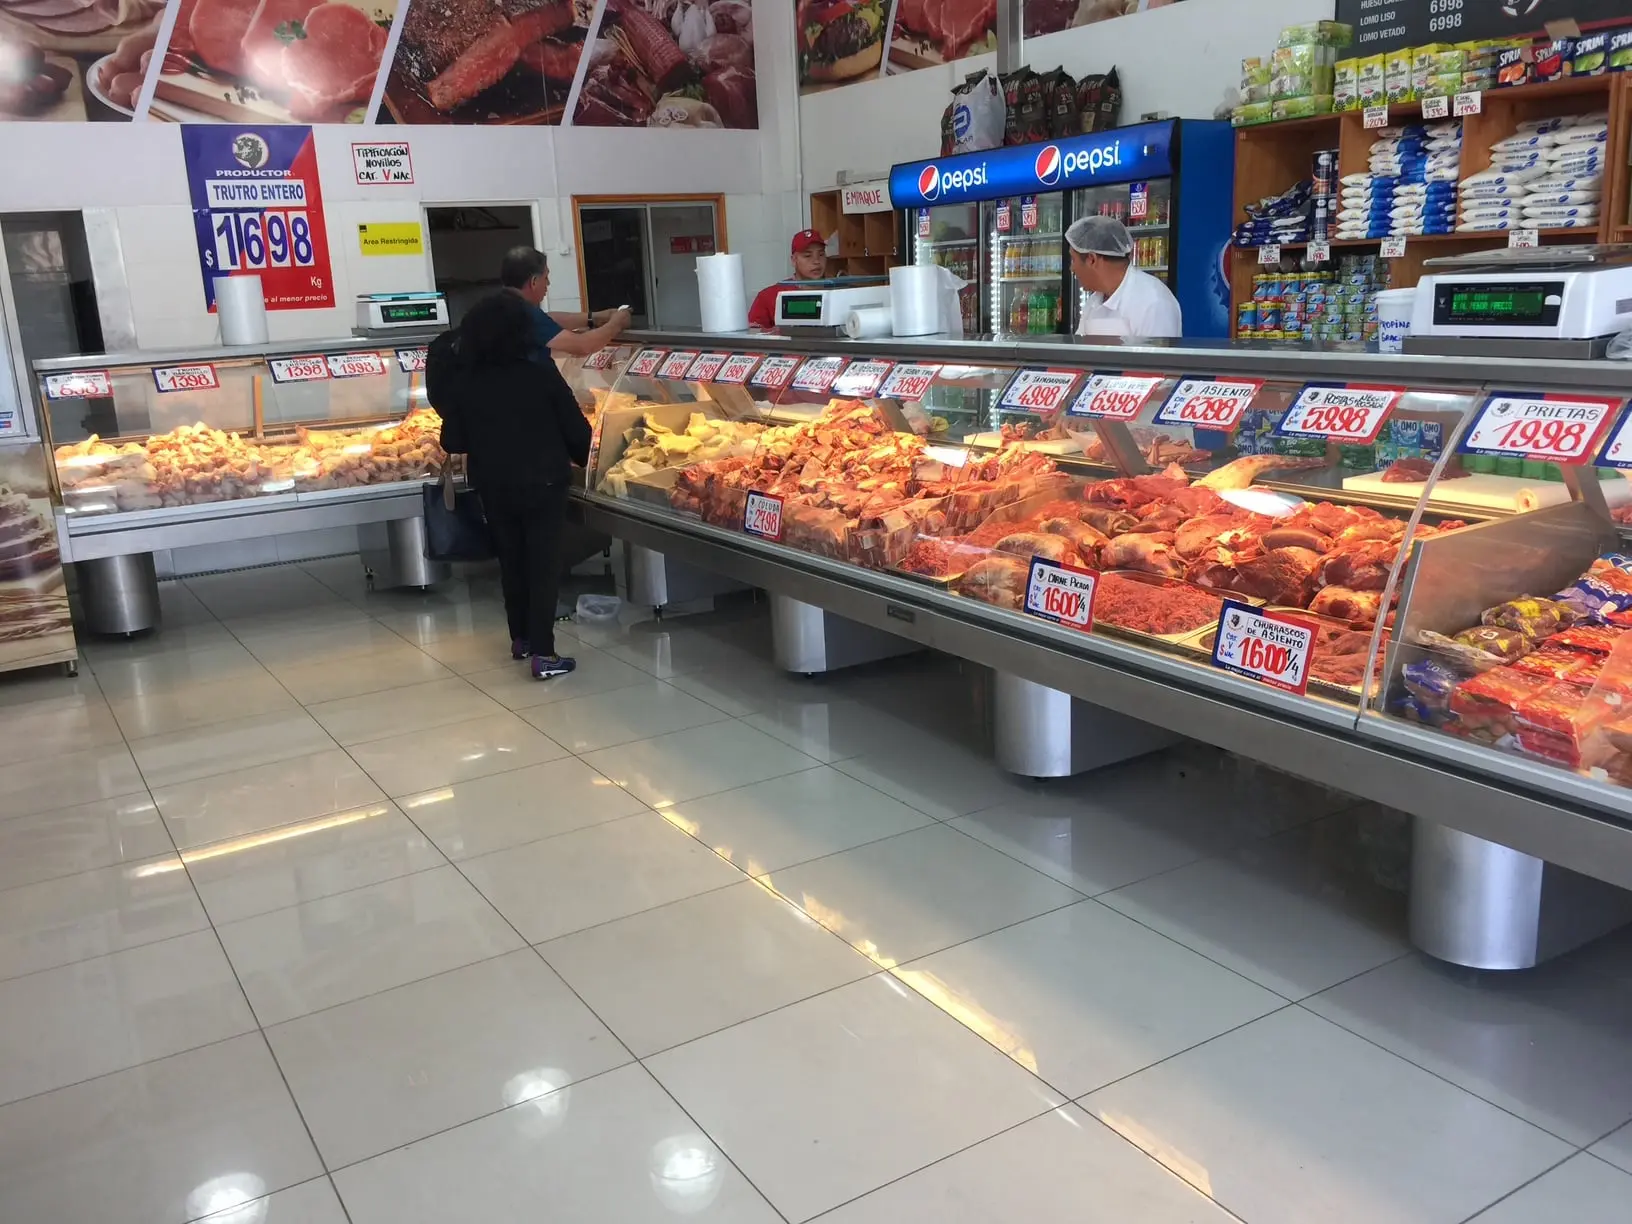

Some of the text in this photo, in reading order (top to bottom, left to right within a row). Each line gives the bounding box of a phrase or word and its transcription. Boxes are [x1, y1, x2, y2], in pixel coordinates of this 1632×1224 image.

[1360, 14, 1379, 26] LOMO
[1380, 11, 1396, 22] LISO
[1360, 13, 1462, 42] LOMO VETADO 6998
[1576, 35, 1605, 56] SPRIM
[1611, 32, 1632, 50] SPRI
[1064, 140, 1121, 179] pepsi
[216, 169, 292, 177] PRODUCTOR
[382, 168, 391, 181] V
[941, 162, 988, 195] pepsi
[213, 184, 304, 201] TRUTRO ENTERO
[204, 214, 313, 267] $ 1698
[380, 237, 419, 246] Restringida
[310, 276, 322, 288] Kg
[270, 293, 328, 303] al menor precio
[1018, 385, 1061, 406] 4998
[1200, 384, 1251, 398] ASIENTO
[1524, 405, 1599, 421] PRIETAS
[1424, 422, 1439, 433] OMO
[1048, 573, 1068, 587] CARNE
[1253, 619, 1306, 640] CHURRASCOS
[1246, 627, 1304, 649] DE ASIENTO
